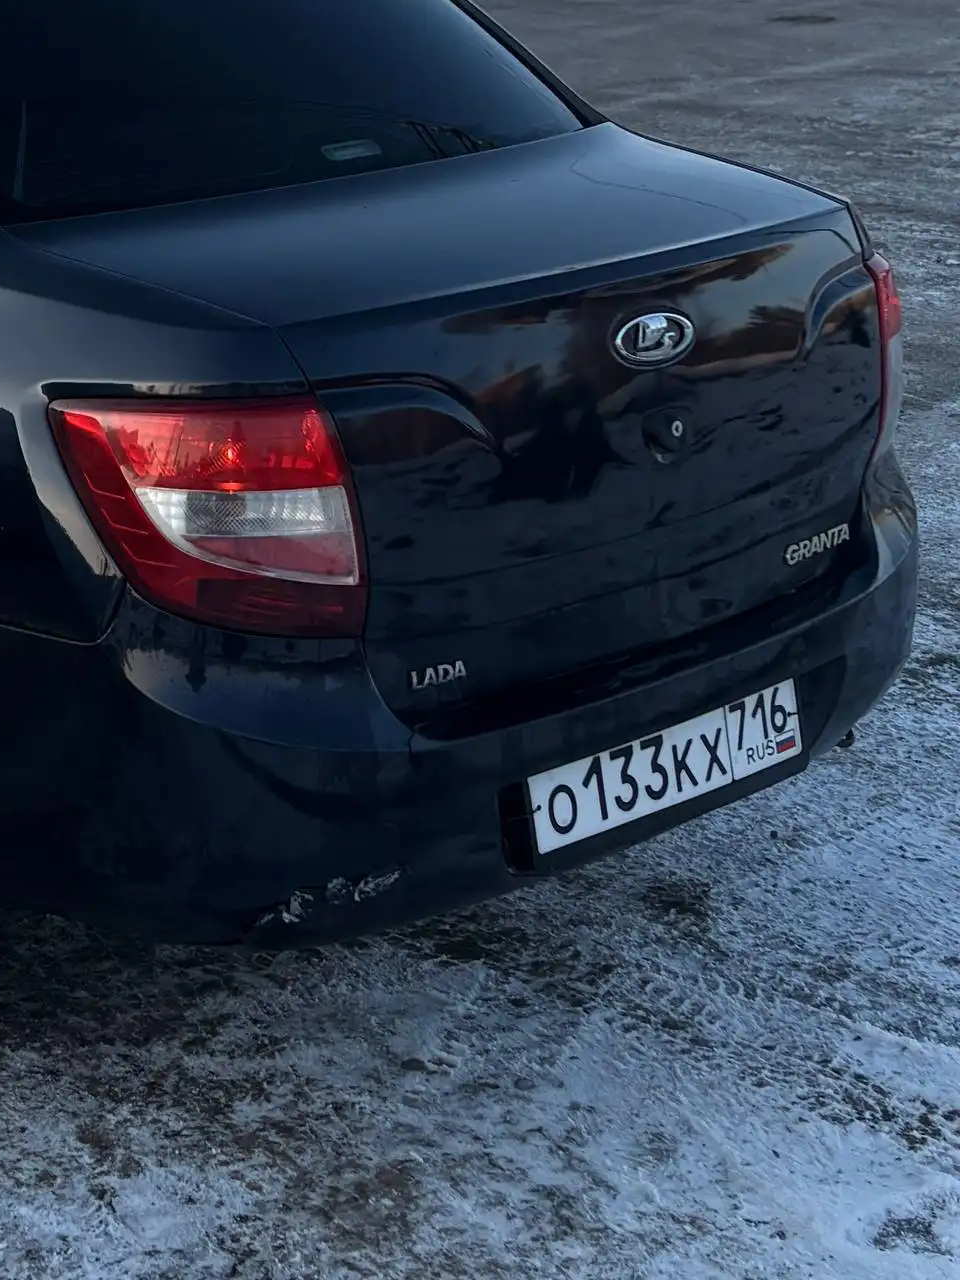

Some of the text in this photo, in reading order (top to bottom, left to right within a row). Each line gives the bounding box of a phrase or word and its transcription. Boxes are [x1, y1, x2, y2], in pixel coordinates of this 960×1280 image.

[785, 523, 850, 566] GRANTA
[410, 659, 467, 690] LADA
[728, 686, 788, 752] 716
[746, 738, 775, 766] RUS
